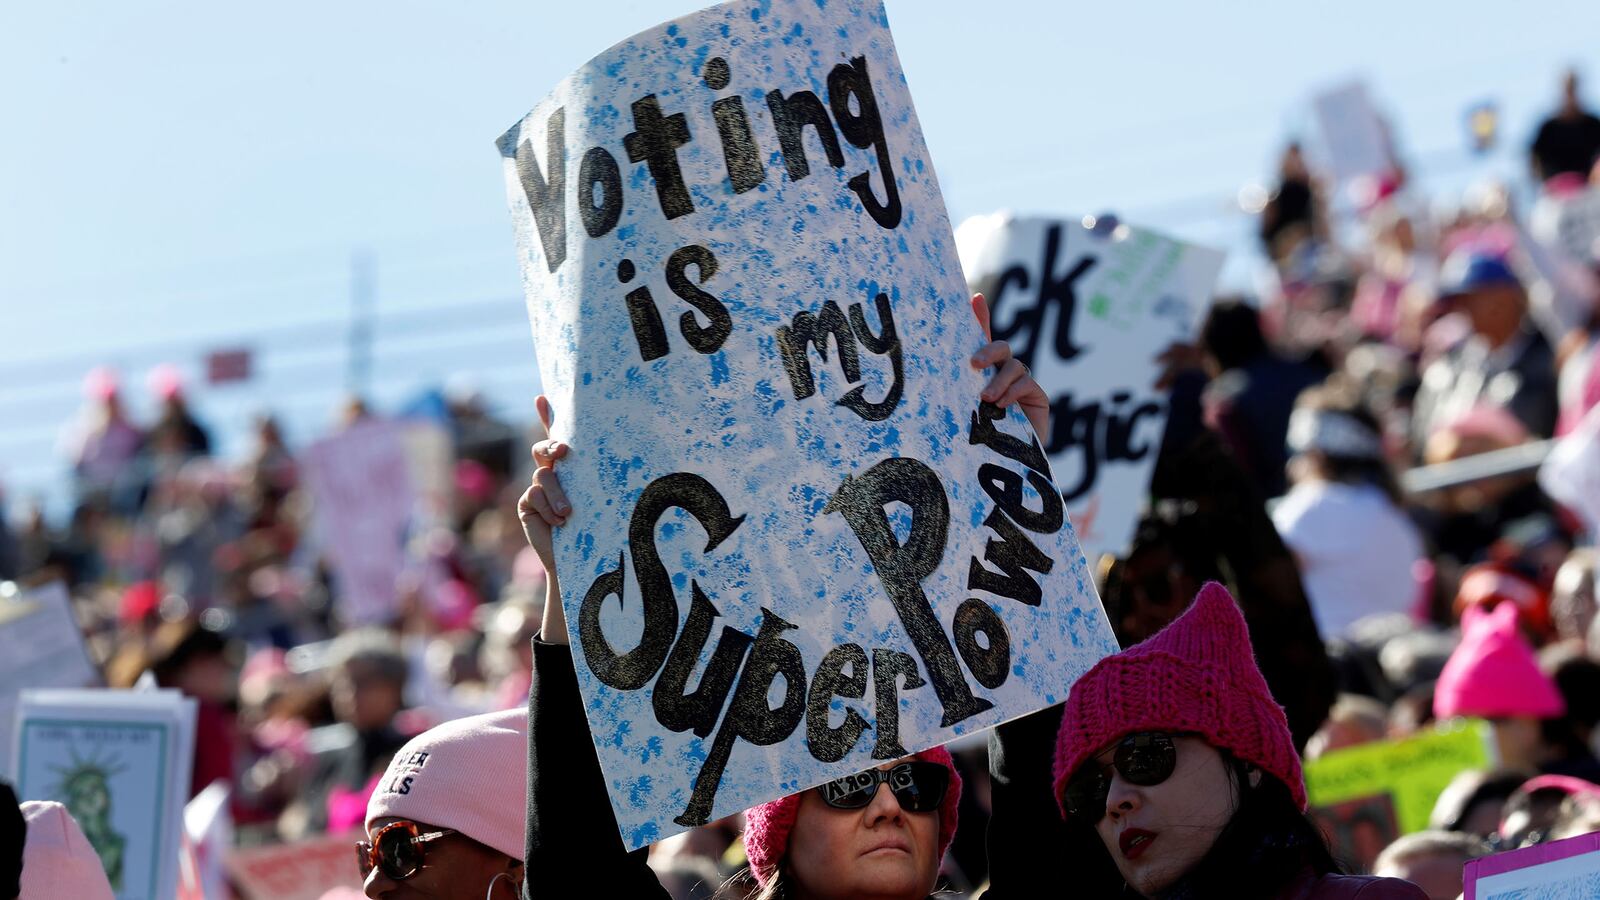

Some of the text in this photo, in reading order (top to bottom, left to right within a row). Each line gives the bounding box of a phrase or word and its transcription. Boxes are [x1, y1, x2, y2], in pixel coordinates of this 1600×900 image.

[515, 54, 902, 272] Voting
[617, 245, 904, 421] is my
